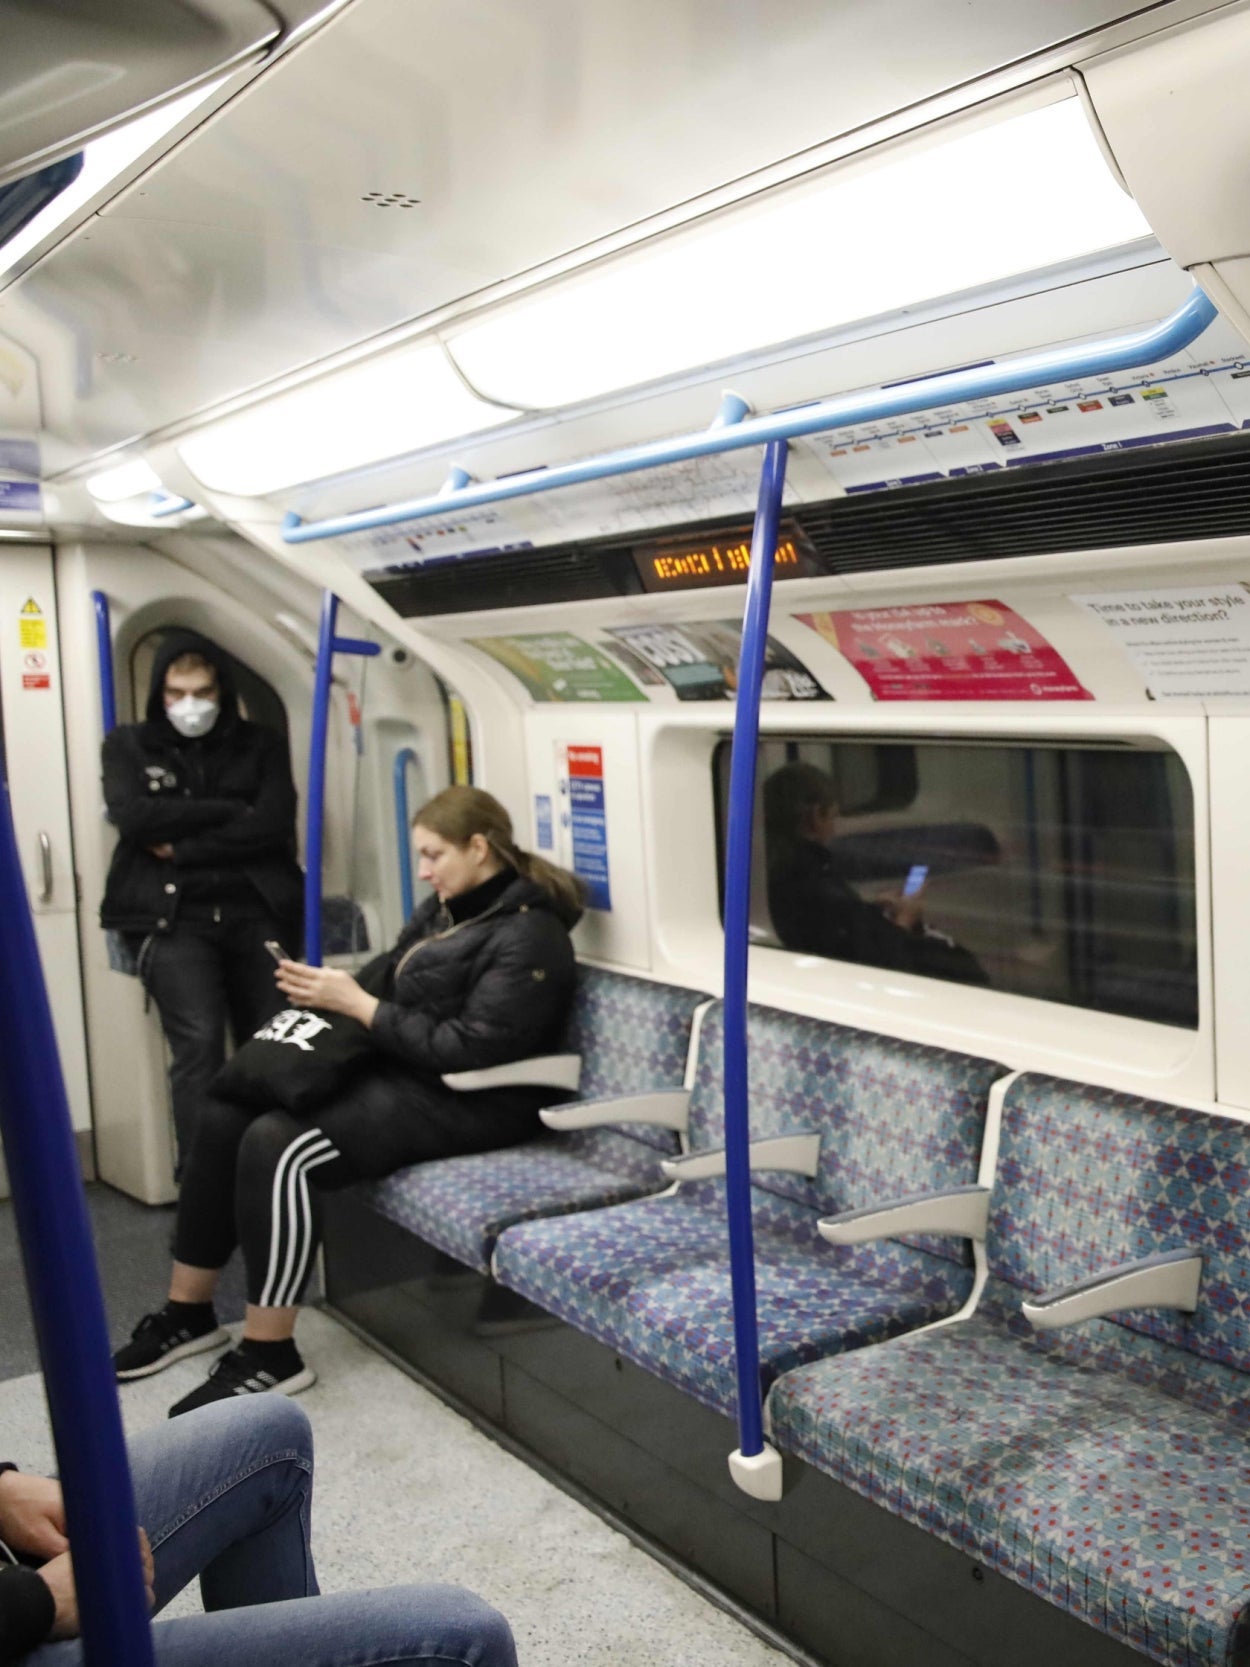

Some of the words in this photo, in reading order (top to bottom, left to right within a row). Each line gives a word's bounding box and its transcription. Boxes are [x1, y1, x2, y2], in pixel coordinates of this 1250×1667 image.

[1087, 601, 1126, 614] Time
[1124, 601, 1142, 612] to
[1141, 599, 1174, 611] take
[1174, 598, 1206, 611] your
[1207, 594, 1245, 609] style
[1130, 615, 1160, 626] new
[1160, 608, 1230, 624] direction?
